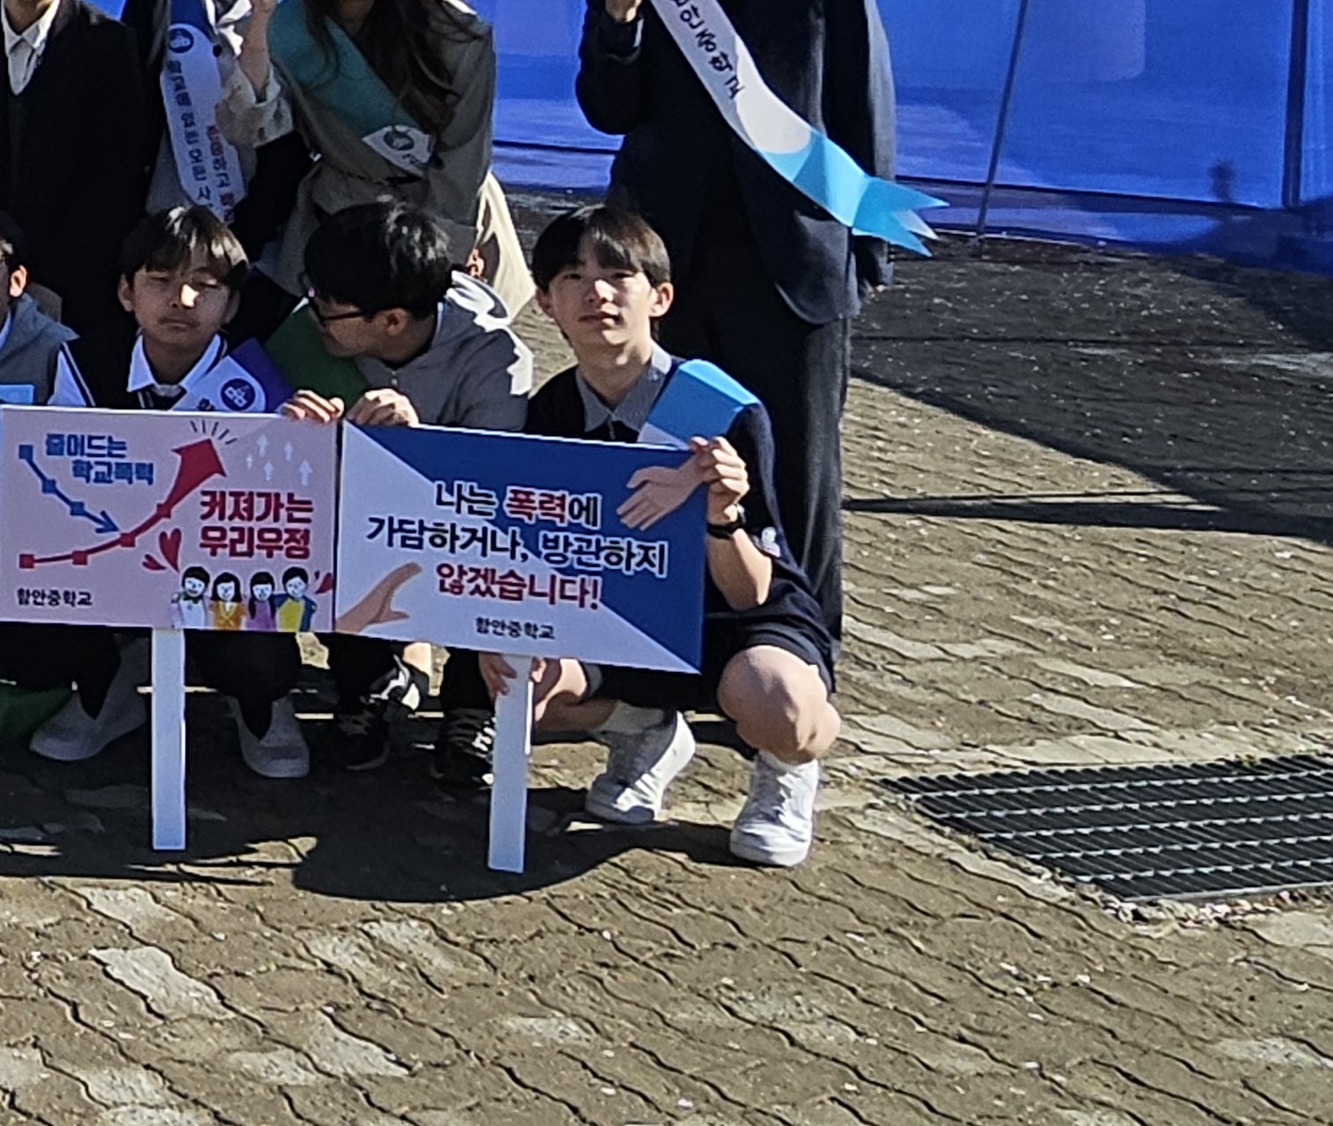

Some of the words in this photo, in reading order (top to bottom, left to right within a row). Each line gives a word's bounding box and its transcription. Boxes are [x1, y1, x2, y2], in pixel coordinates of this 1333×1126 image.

[45, 433, 128, 459] 줄어드는
[72, 459, 155, 486] 학교폭력
[199, 489, 314, 524] 커져가는
[435, 482, 496, 518] 나는
[505, 487, 600, 529] 폭력에
[199, 525, 312, 560] 우리우정
[367, 515, 529, 562] 가담하거나,
[539, 532, 668, 576] 방관하지
[16, 587, 94, 608] 함안중학교
[435, 562, 603, 611] 않겠습니다!
[475, 616, 556, 640] 함안중학교
